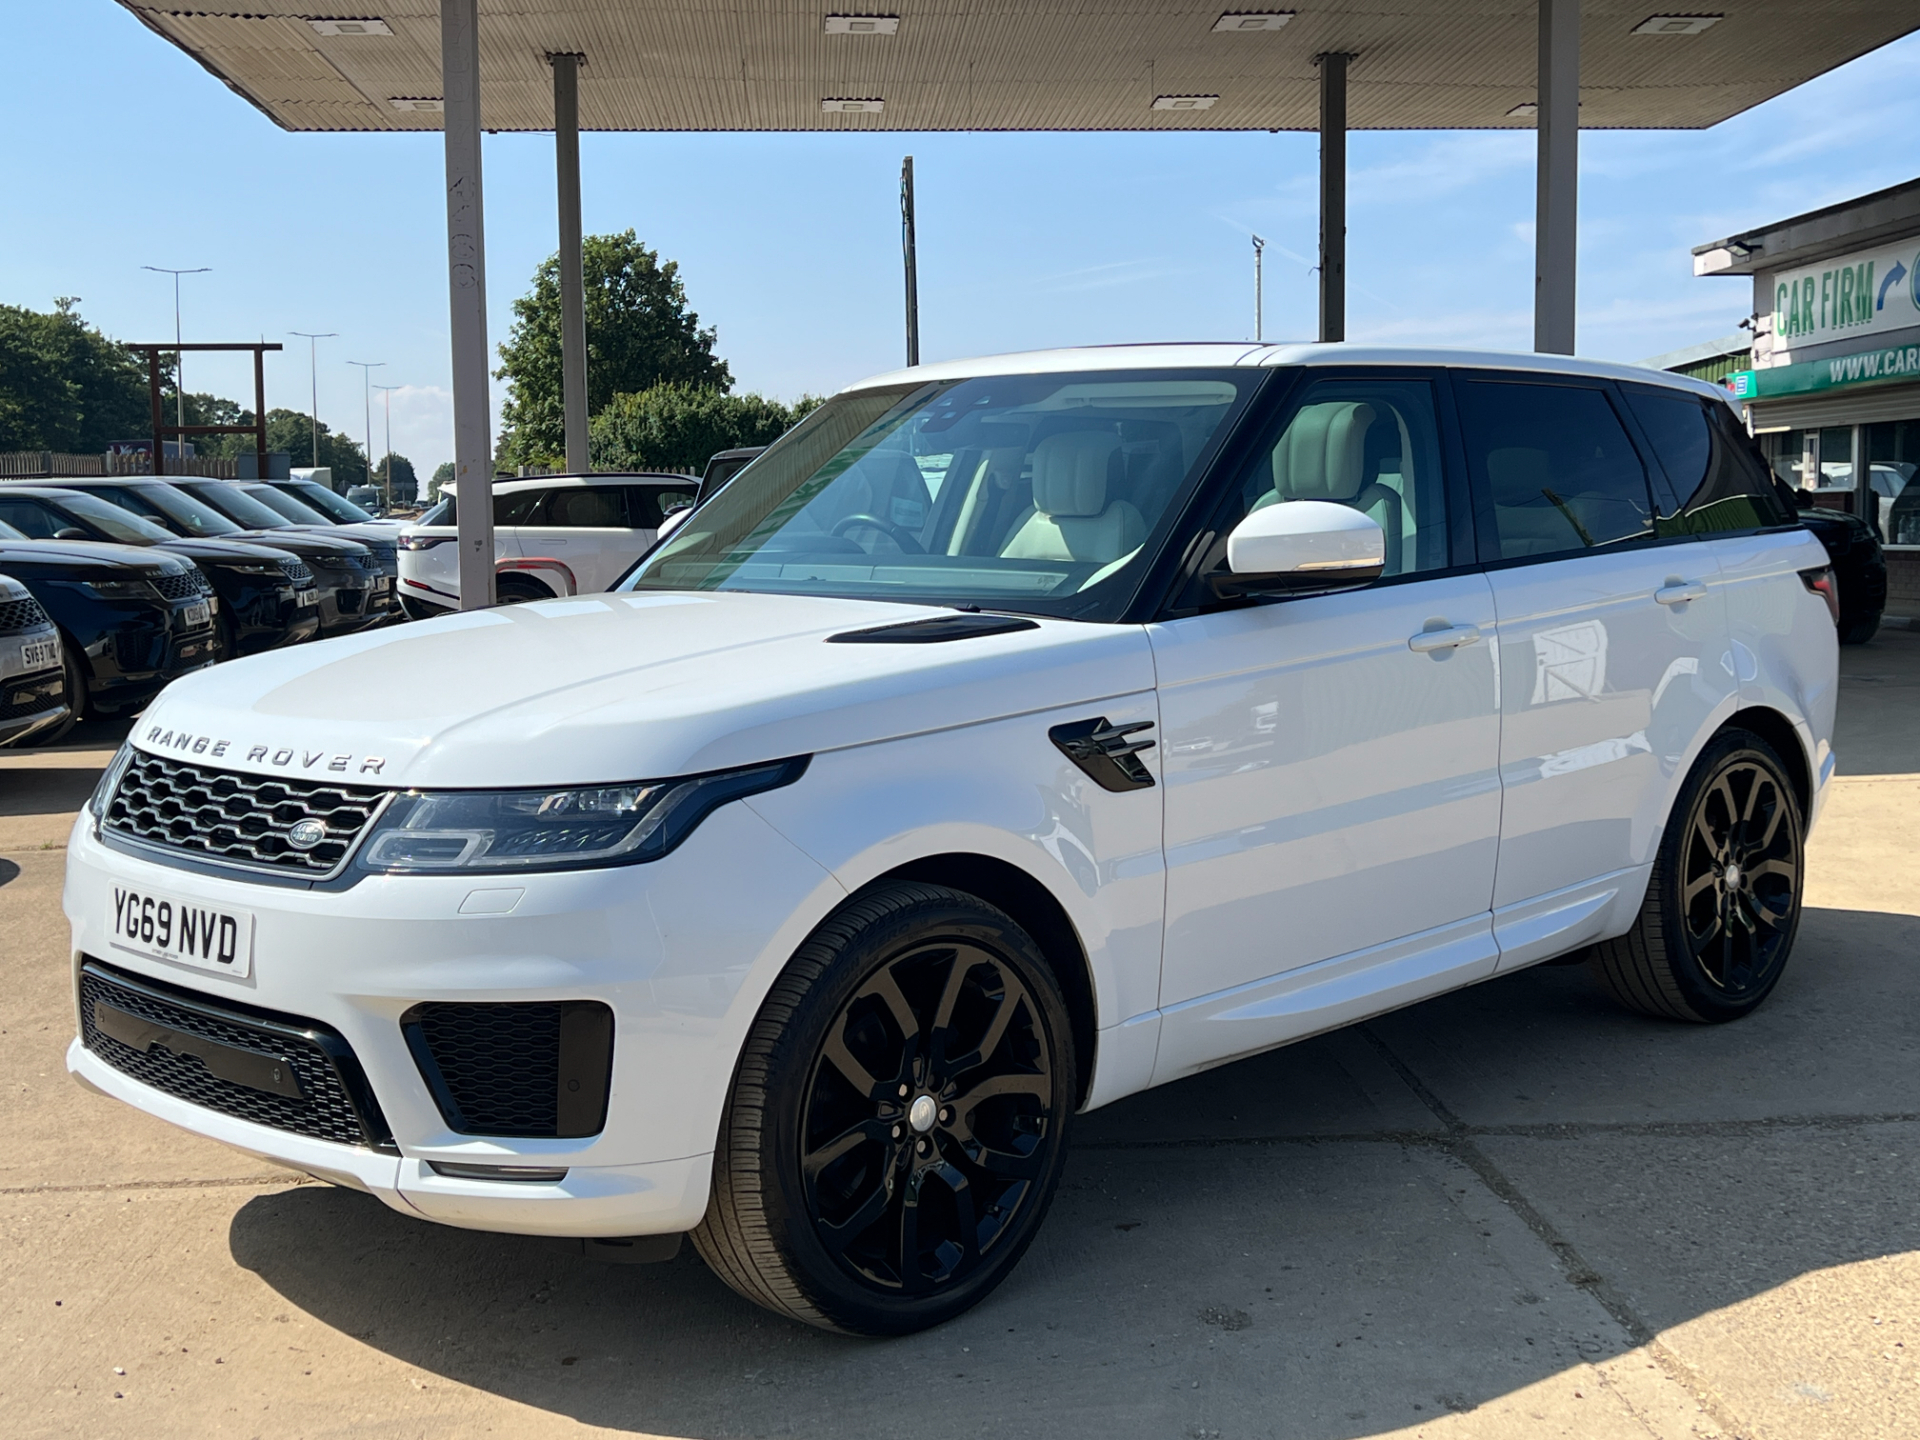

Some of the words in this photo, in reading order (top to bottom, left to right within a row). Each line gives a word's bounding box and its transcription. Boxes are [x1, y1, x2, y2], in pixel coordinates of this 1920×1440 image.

[1776, 276, 1815, 338] CAR
[1821, 261, 1874, 330] FIRM
[1829, 348, 1920, 383] WWW.CAR
[147, 726, 231, 757] RANGE
[247, 744, 386, 775] ROVER
[114, 887, 172, 948] YG69
[178, 905, 237, 965] NVD
